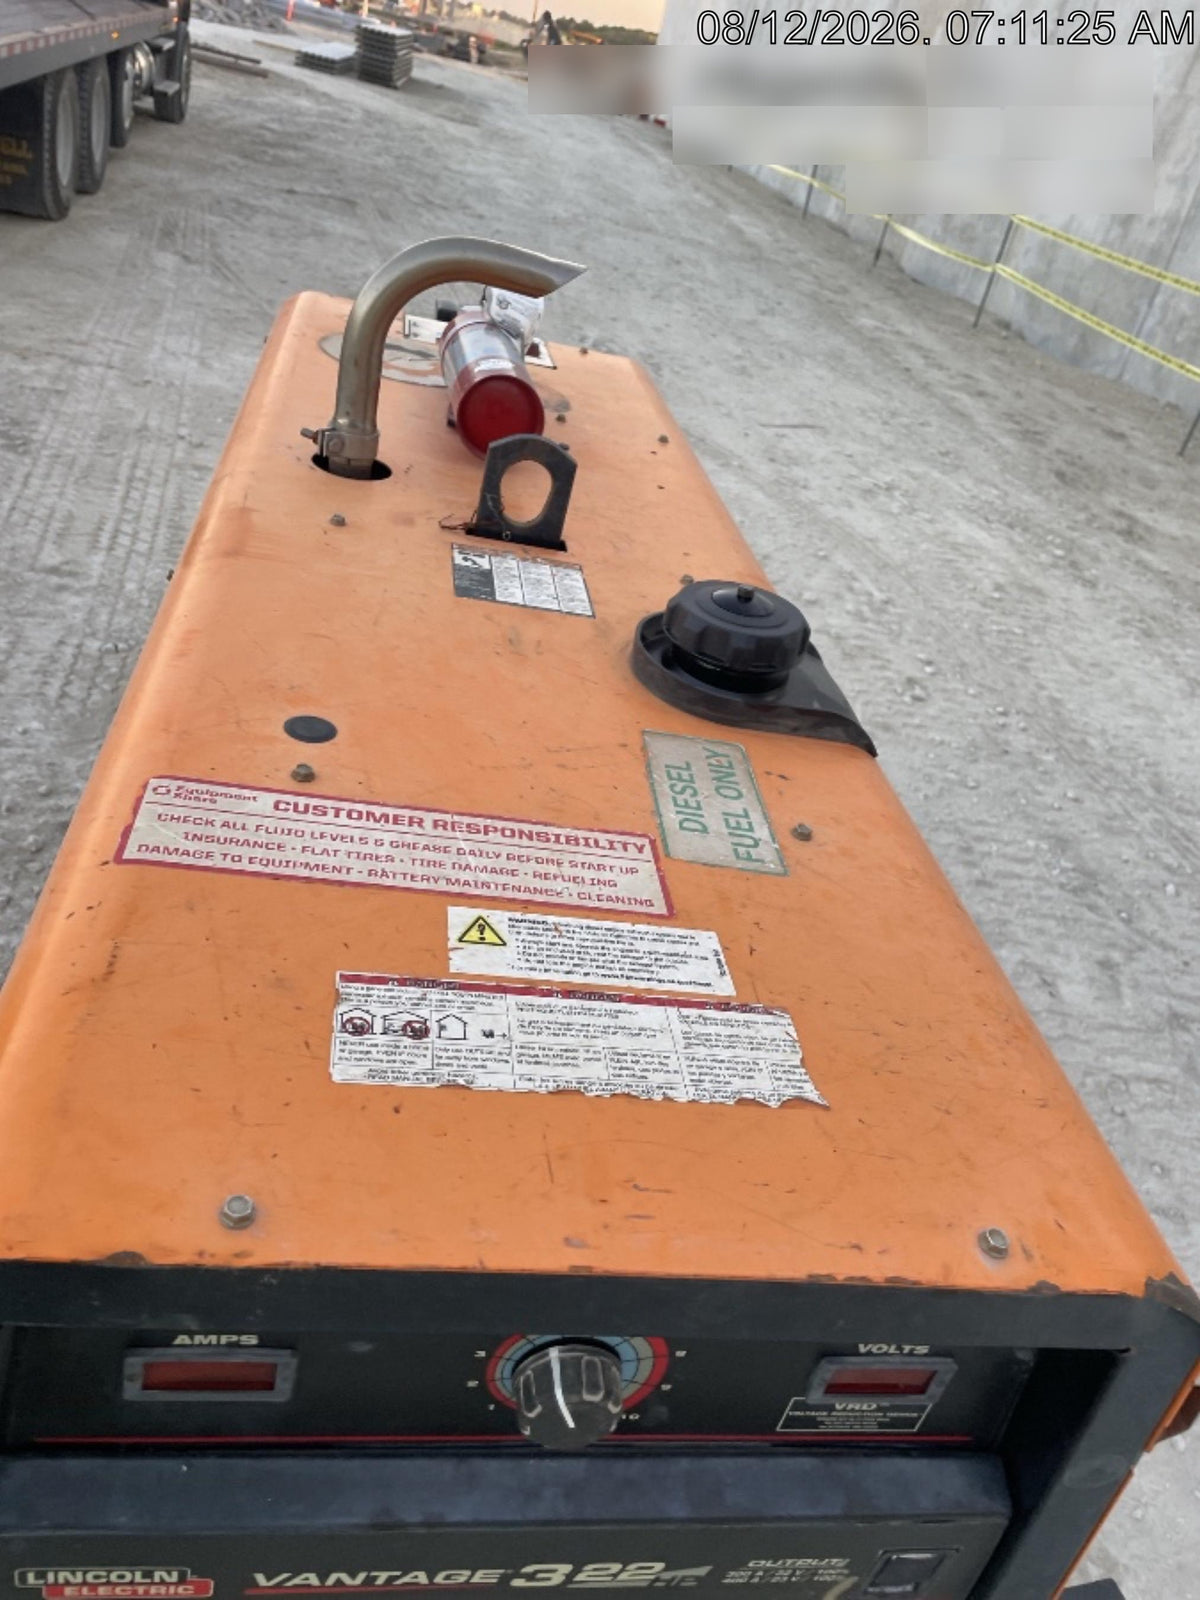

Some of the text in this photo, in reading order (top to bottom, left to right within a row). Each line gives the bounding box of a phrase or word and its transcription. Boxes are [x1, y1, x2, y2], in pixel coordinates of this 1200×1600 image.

[664, 760, 710, 835] DIESEL
[703, 746, 765, 863] FUEL ONLY
[157, 812, 216, 828] CHECK
[220, 820, 248, 832] ALL
[255, 824, 305, 838] FLUID
[310, 831, 369, 846] LEVELS
[390, 840, 452, 855] GREASE
[456, 847, 502, 860] DAILY
[506, 853, 565, 868] BEFORE
[273, 799, 647, 855] CUSTOMER RESPONSIBILITY
[136, 843, 215, 861] DAMAGE
[220, 852, 243, 863] TO
[248, 856, 354, 876] EQUIPMENT
[368, 868, 441, 884] BATTERY
[445, 877, 563, 898] MAINTENANCE
[577, 891, 655, 908] CLEANING
[183, 831, 287, 852] INSURANCE
[301, 845, 341, 858] FLAT
[344, 849, 395, 863] TIRES
[409, 857, 447, 870] TIRE
[451, 862, 520, 877] DAMAGE
[533, 871, 618, 888] REFUELING
[172, 1334, 260, 1346] AMPS
[858, 1343, 930, 1355] VOLTS
[27, 1570, 180, 1585] LINCOLN
[63, 1584, 196, 1598] ELECTRIC
[253, 1567, 506, 1588] VANTAGE
[510, 1561, 666, 1588] 322
